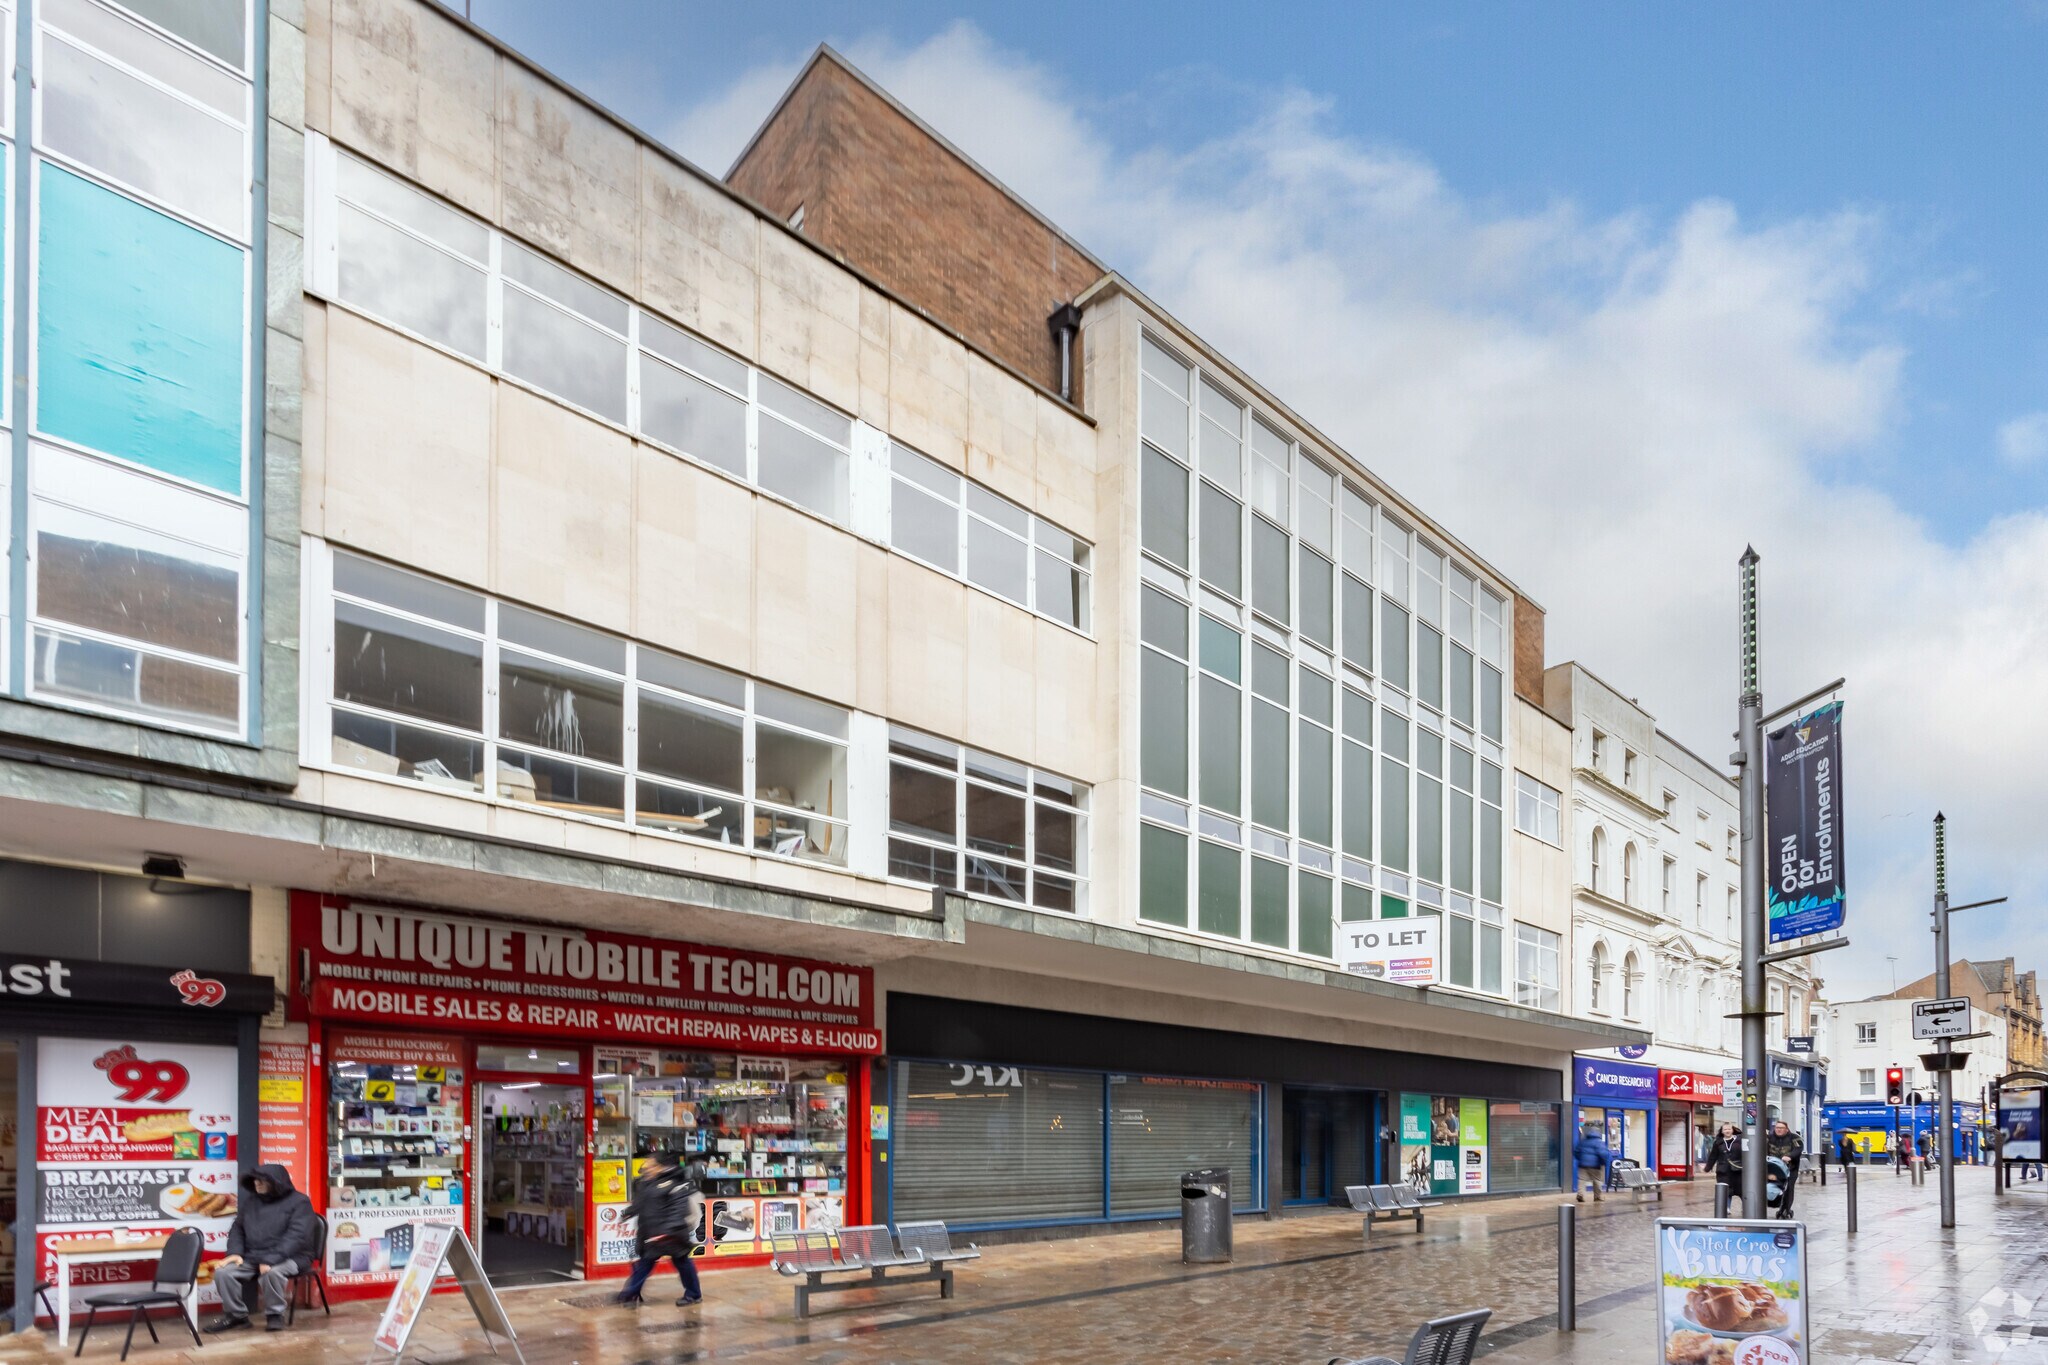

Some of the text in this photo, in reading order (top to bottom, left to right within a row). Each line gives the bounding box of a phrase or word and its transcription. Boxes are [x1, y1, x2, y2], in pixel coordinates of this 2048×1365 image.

[1796, 735, 1829, 754] EDUCATION
[1815, 757, 1832, 883] Enrolments
[1782, 834, 1797, 893] OPEN
[1798, 859, 1814, 889] for
[1351, 930, 1427, 949] TO LET
[321, 906, 860, 1007] UNIQUE MOBILE TECH.COM
[0, 960, 71, 998] st
[178, 978, 227, 1007] 99
[319, 962, 858, 1025] MOBILE PHONE REPAIRS PHONE ACCESSORIES WATCH & JEWELLERY REPAIRS SMOKING & VAPE SUPPLIES
[332, 988, 428, 1016] MOBILE
[433, 996, 502, 1021] SALES
[507, 1002, 523, 1023] &
[528, 1004, 598, 1028] REPAIR
[614, 1012, 679, 1036] WATCH
[801, 1029, 812, 1046] &
[815, 1030, 877, 1051] E-LIQUID
[344, 1036, 385, 1048] MOBILE
[387, 1039, 443, 1050] UNLOCKING
[335, 1047, 457, 1063] ACCESSORIES BUY & SELL
[107, 1059, 190, 1104] 99
[1596, 1073, 1618, 1084] CANCER
[1619, 1076, 1643, 1087] RESEARCH
[1700, 1081, 1717, 1095] Heart
[45, 1108, 127, 1126] MEAL
[46, 1126, 127, 1144] DEAL
[45, 1144, 173, 1153] BAGUETTE OR SANDWICH
[53, 1153, 90, 1161] CRISPS
[44, 1170, 185, 1186] BREAKFAST
[45, 1185, 144, 1200] (REGULAR)
[44, 1211, 159, 1222] FREE TEA OR COFFEE
[334, 1208, 456, 1220] FAST, PROFESSIONAL REPAIRS
[1697, 1236, 1732, 1252] Hot
[1667, 1226, 1786, 1283] Buns
[69, 1265, 131, 1282] FRIES
[331, 1275, 348, 1284] NO
[349, 1274, 364, 1283] FIX
[1750, 1345, 1789, 1363] 4 FOR
